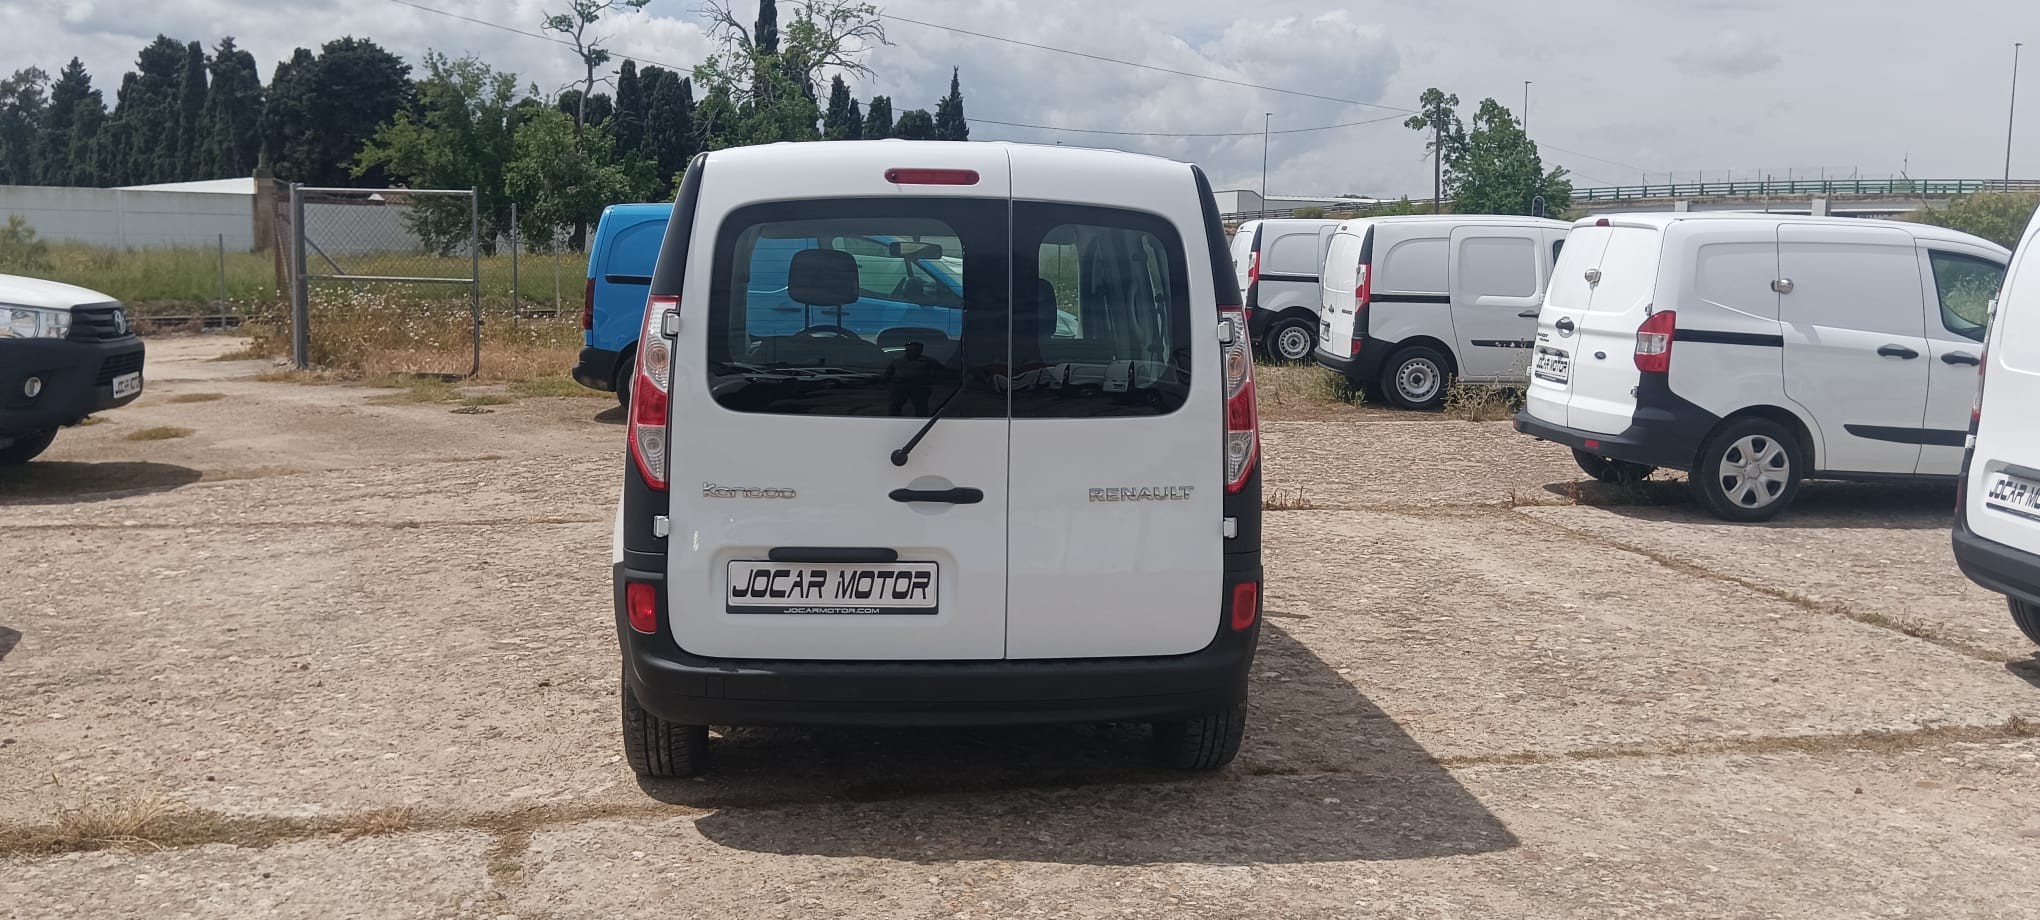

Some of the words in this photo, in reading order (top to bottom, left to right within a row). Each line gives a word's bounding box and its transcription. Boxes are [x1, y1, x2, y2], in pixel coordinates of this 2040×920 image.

[703, 481, 797, 499] Kangoo
[1088, 485, 1195, 503] RENAULT
[1988, 479, 2028, 505] JOCAR
[732, 568, 828, 599] JOCAR
[834, 570, 932, 600] MOTOR
[783, 606, 880, 615] JOCARMOTOR.COM
